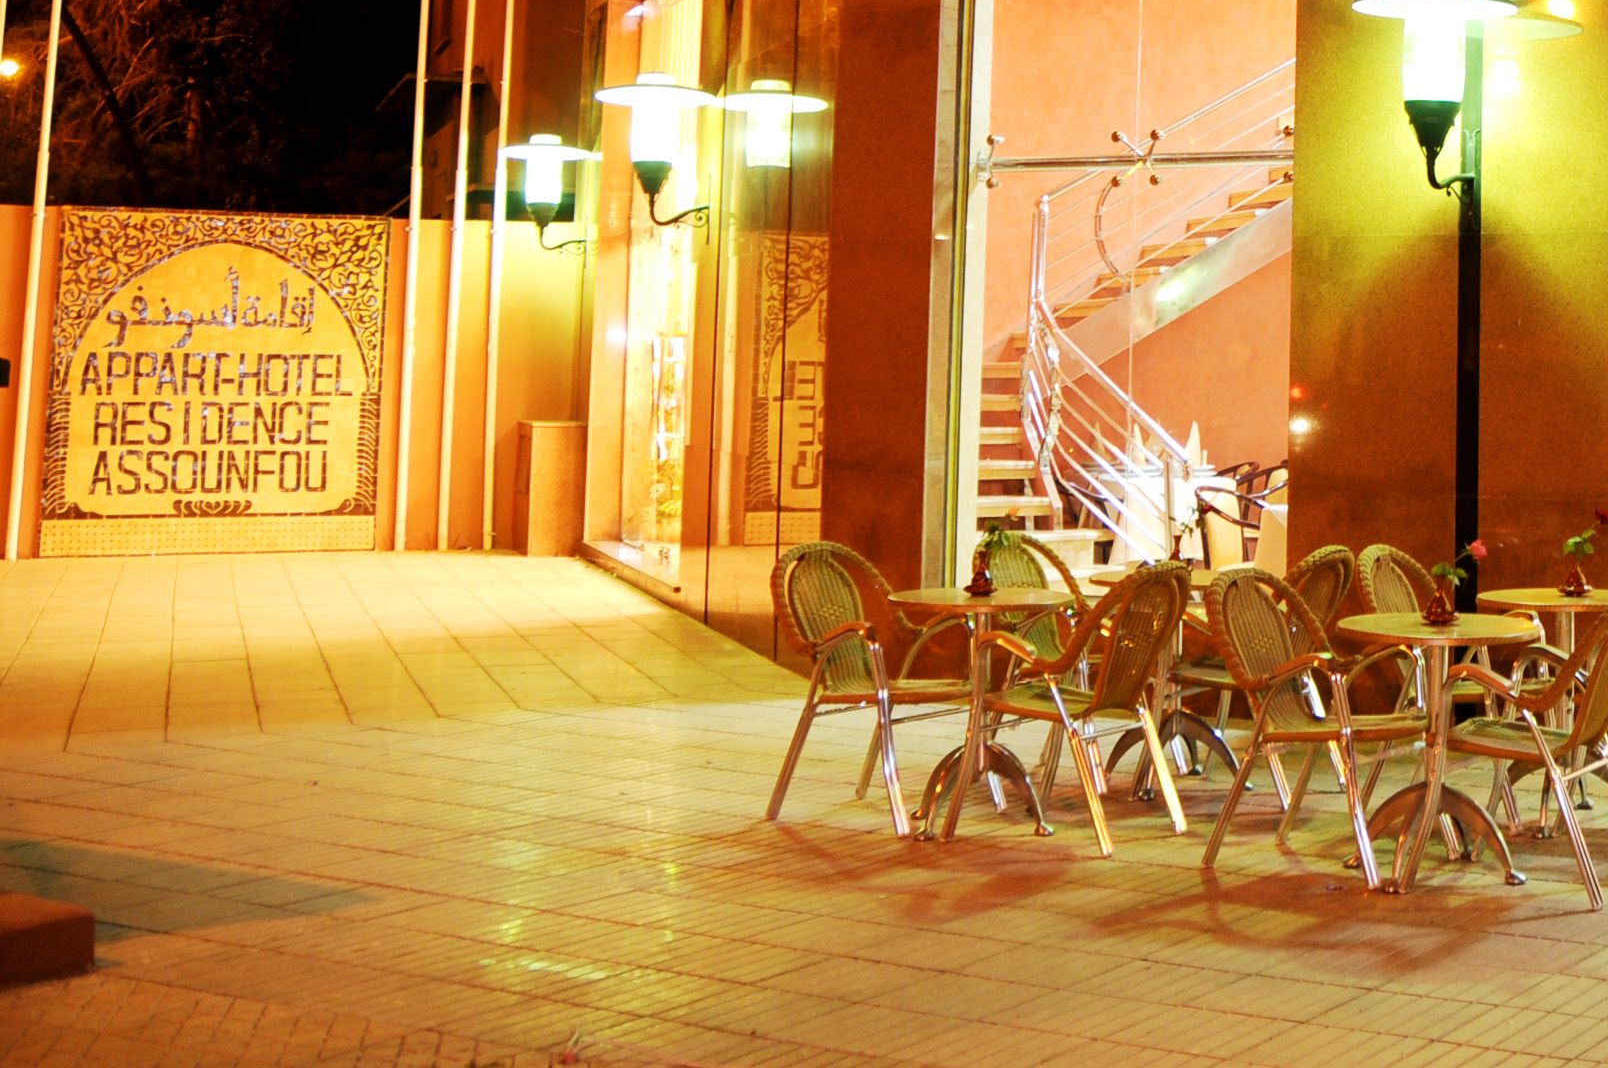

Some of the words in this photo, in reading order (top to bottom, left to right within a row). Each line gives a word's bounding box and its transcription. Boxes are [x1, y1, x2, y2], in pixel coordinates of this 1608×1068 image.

[240, 279, 316, 336] إقامة
[79, 351, 353, 397] APPART-HOTEL
[92, 401, 331, 447] RESIDENCE
[88, 449, 328, 496] ASSOUNFOU
